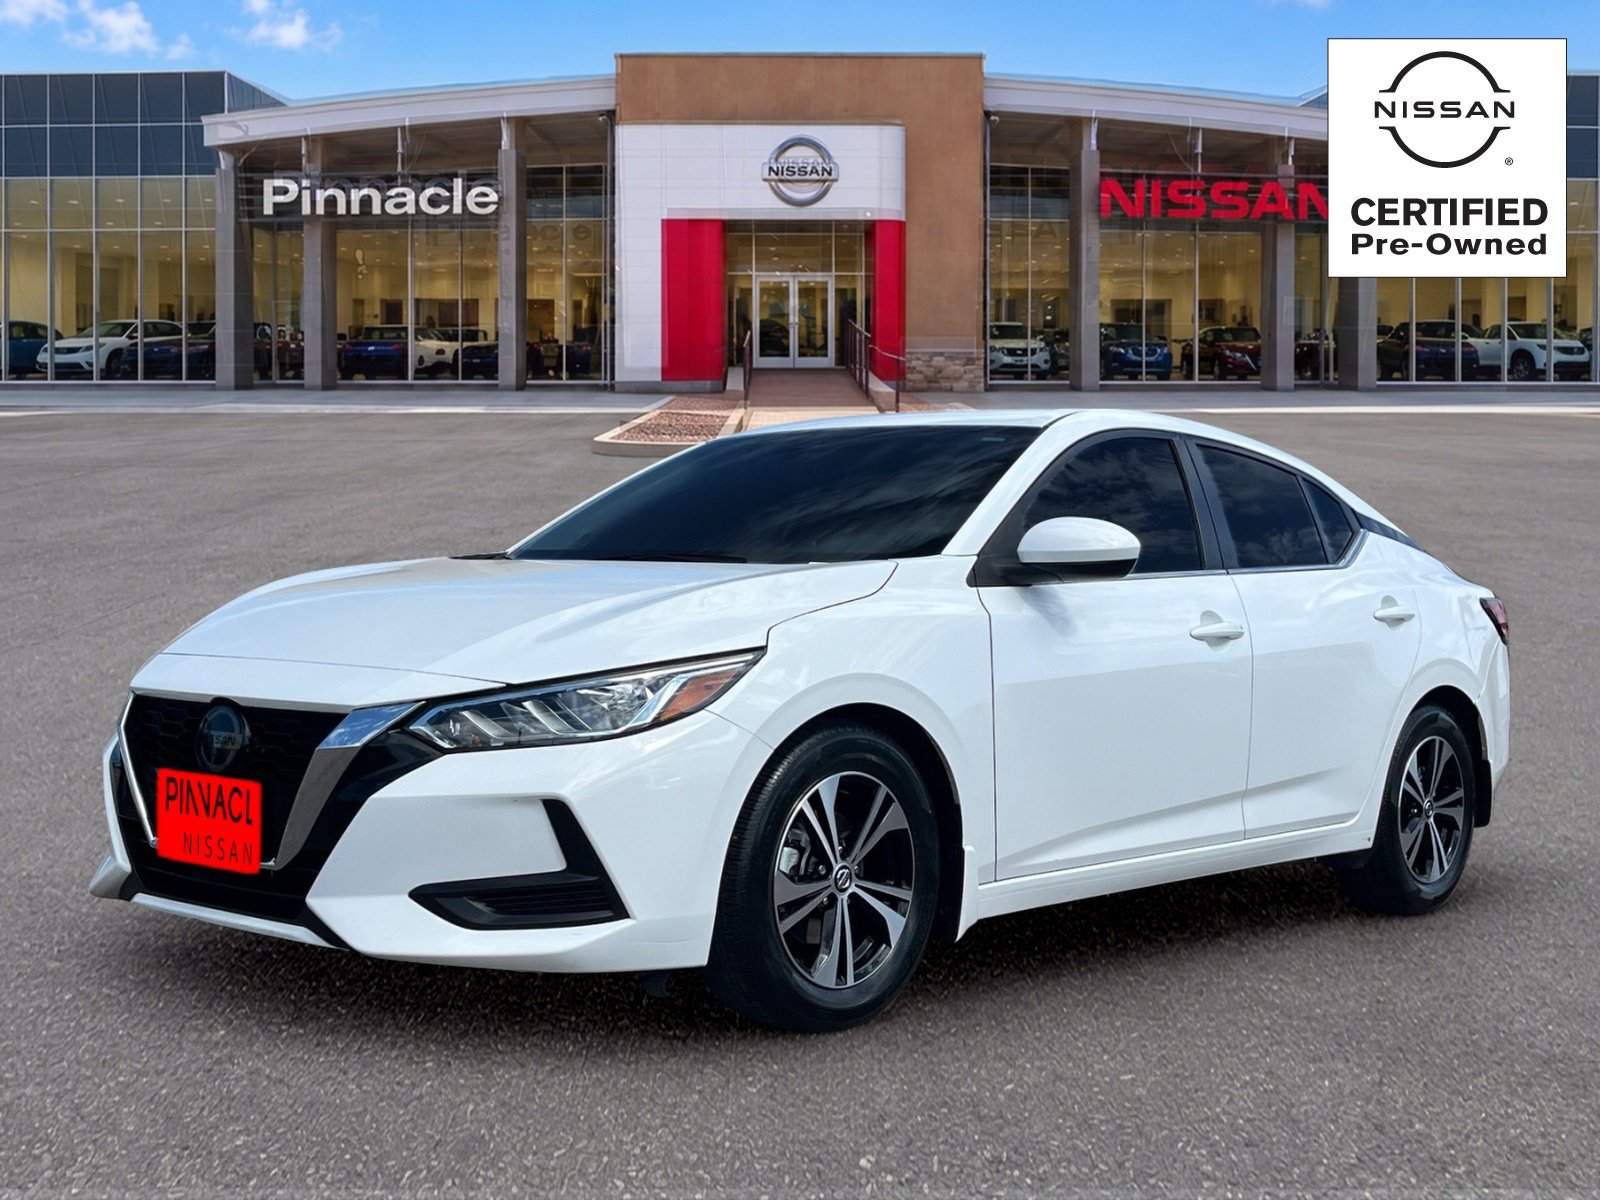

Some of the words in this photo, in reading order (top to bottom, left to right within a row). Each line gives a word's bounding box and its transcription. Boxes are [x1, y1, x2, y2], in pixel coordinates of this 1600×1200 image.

[768, 166, 832, 177] NISSAN
[263, 178, 499, 216] Pinnacle
[1100, 179, 1328, 220] NISSAN
[183, 832, 253, 865] NISSAN
